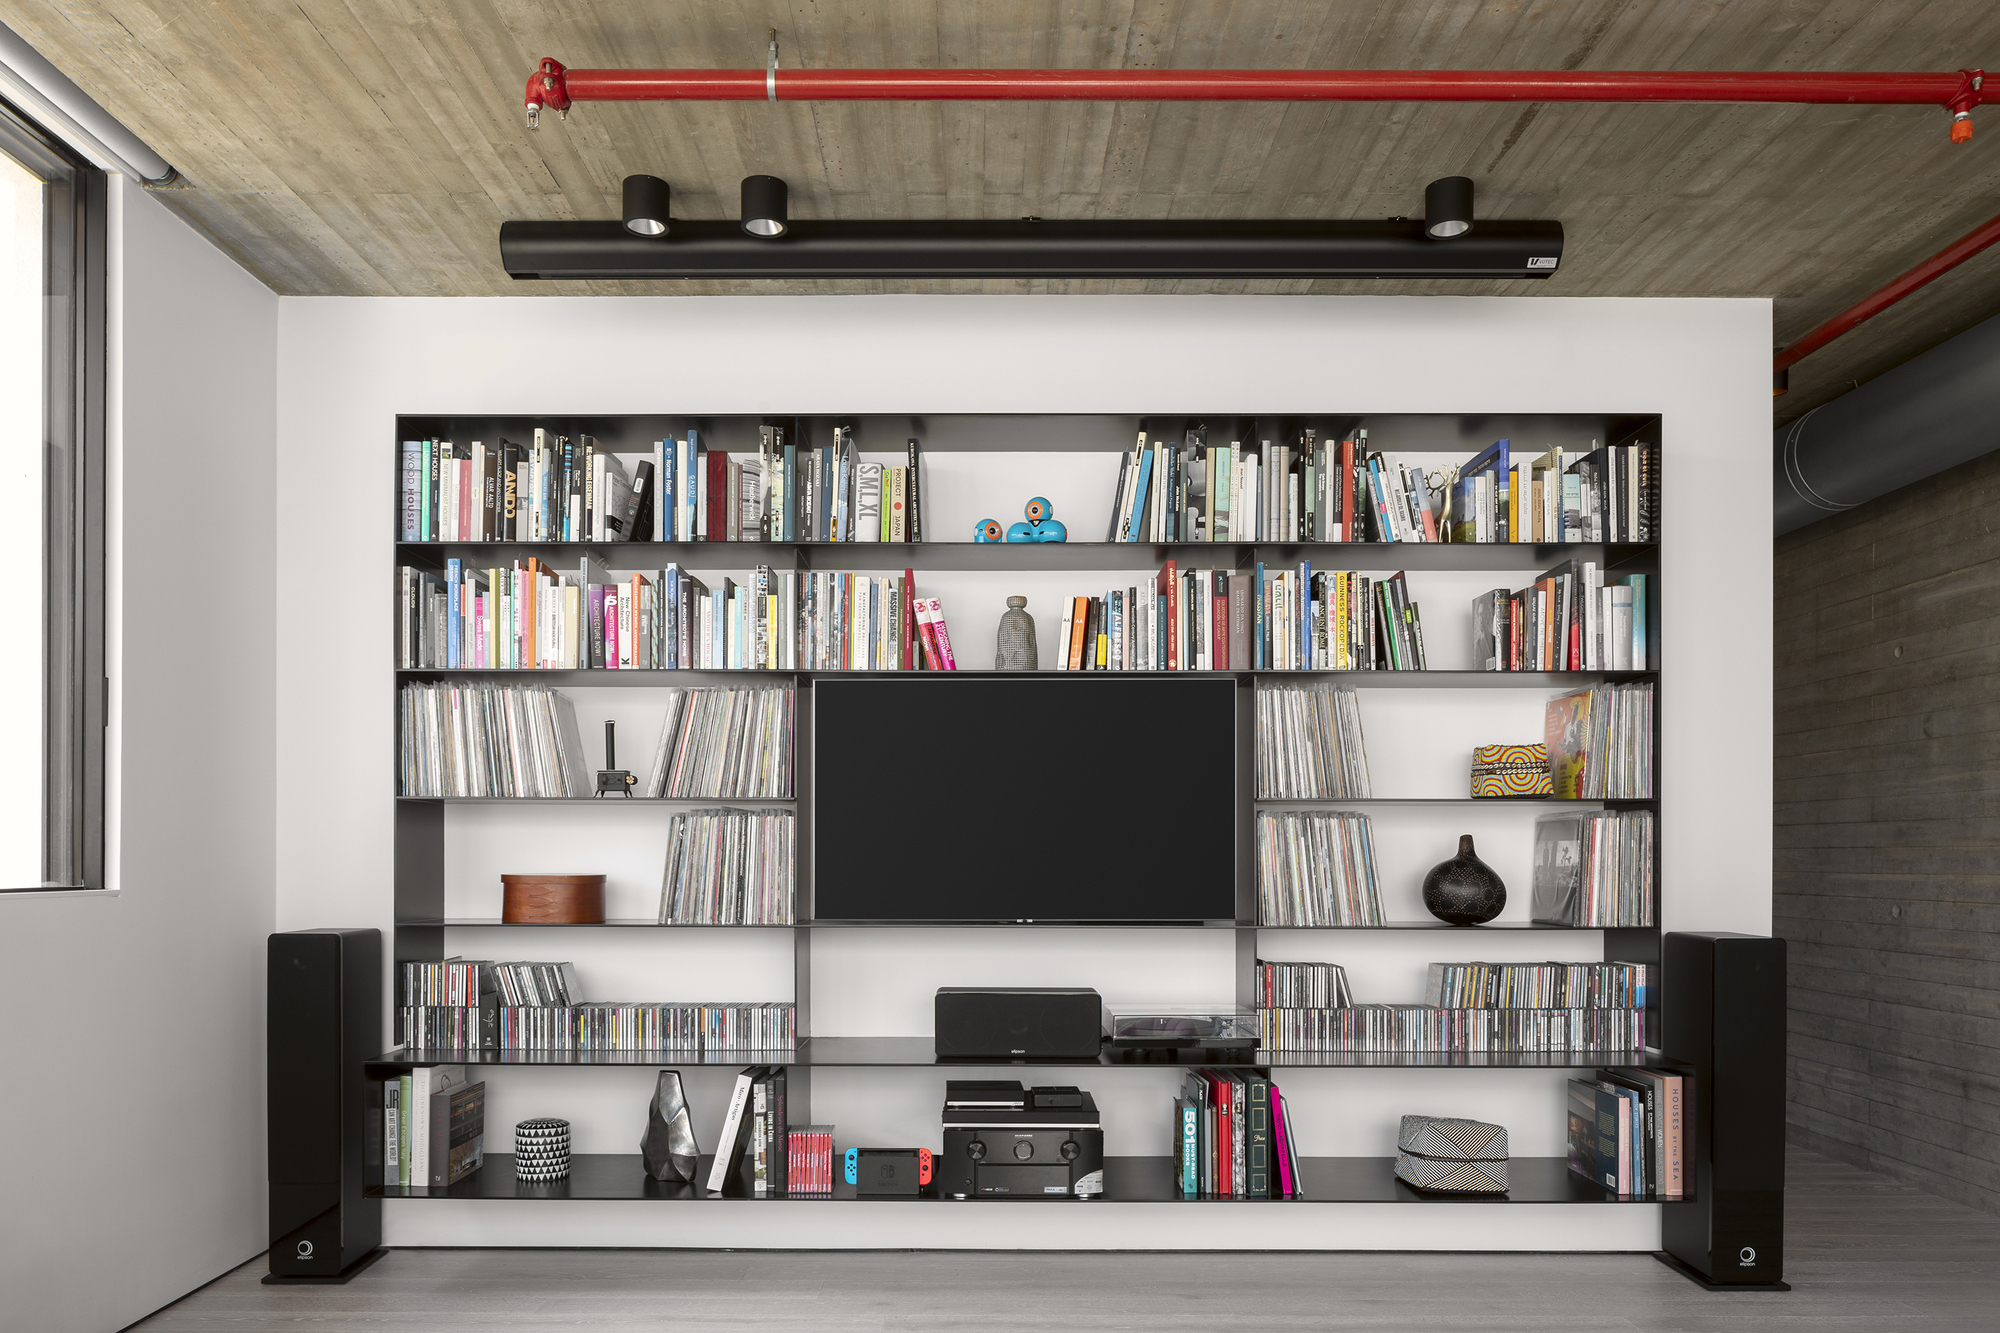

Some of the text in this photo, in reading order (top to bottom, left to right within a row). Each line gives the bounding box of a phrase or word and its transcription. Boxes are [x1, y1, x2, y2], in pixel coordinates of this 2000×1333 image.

[506, 470, 516, 518] ANDO
[857, 465, 879, 520] S,M,L,XL
[608, 596, 617, 606] 10
[927, 627, 937, 655] JAPANESE
[938, 634, 947, 656] CENTURY
[941, 622, 950, 651] DESIGNING
[386, 1089, 399, 1109] JR
[731, 1101, 740, 1121] Artigas
[1185, 1110, 1195, 1143] 501
[1278, 1132, 1287, 1167] LACHAPELLE
